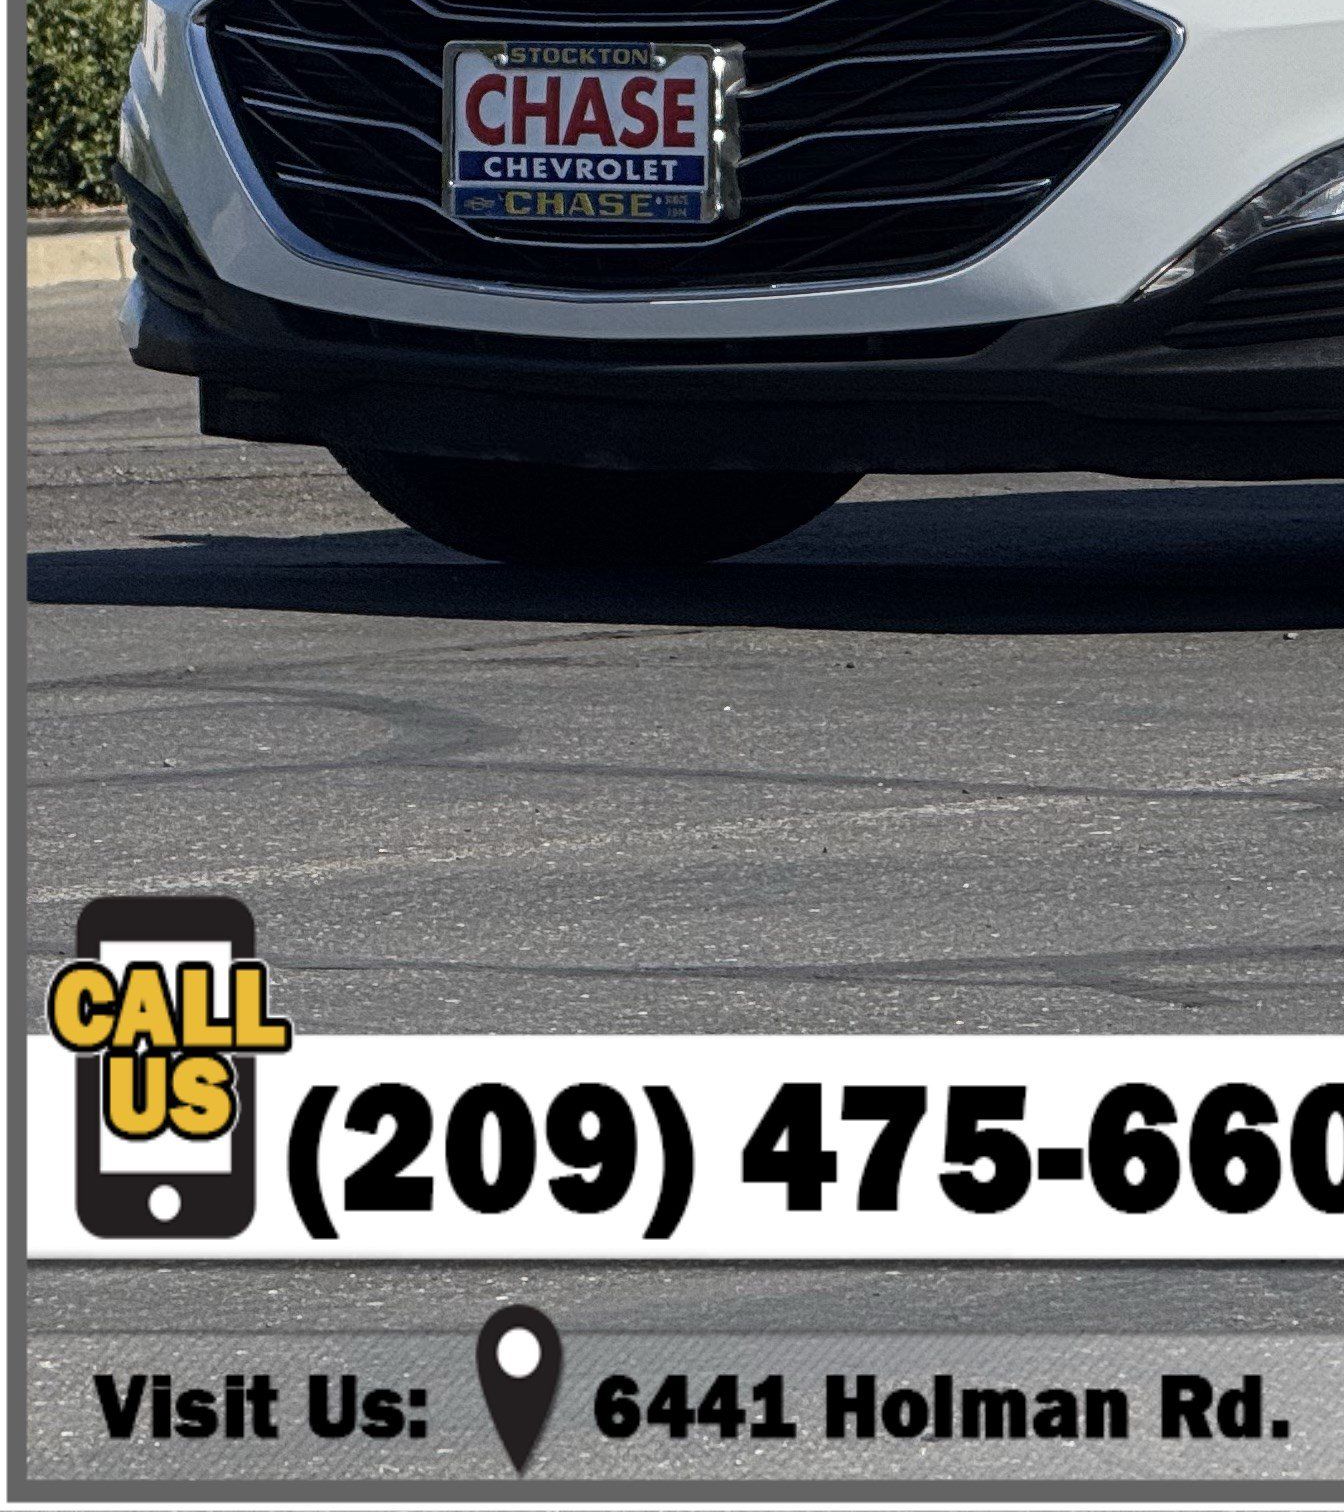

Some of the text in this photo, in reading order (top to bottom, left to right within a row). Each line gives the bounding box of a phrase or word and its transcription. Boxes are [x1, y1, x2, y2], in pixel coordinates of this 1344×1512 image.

[508, 47, 648, 66] STOCKTON
[465, 73, 696, 149] CHASE
[483, 156, 679, 181] CHEVROLET
[504, 191, 653, 217] CHASE
